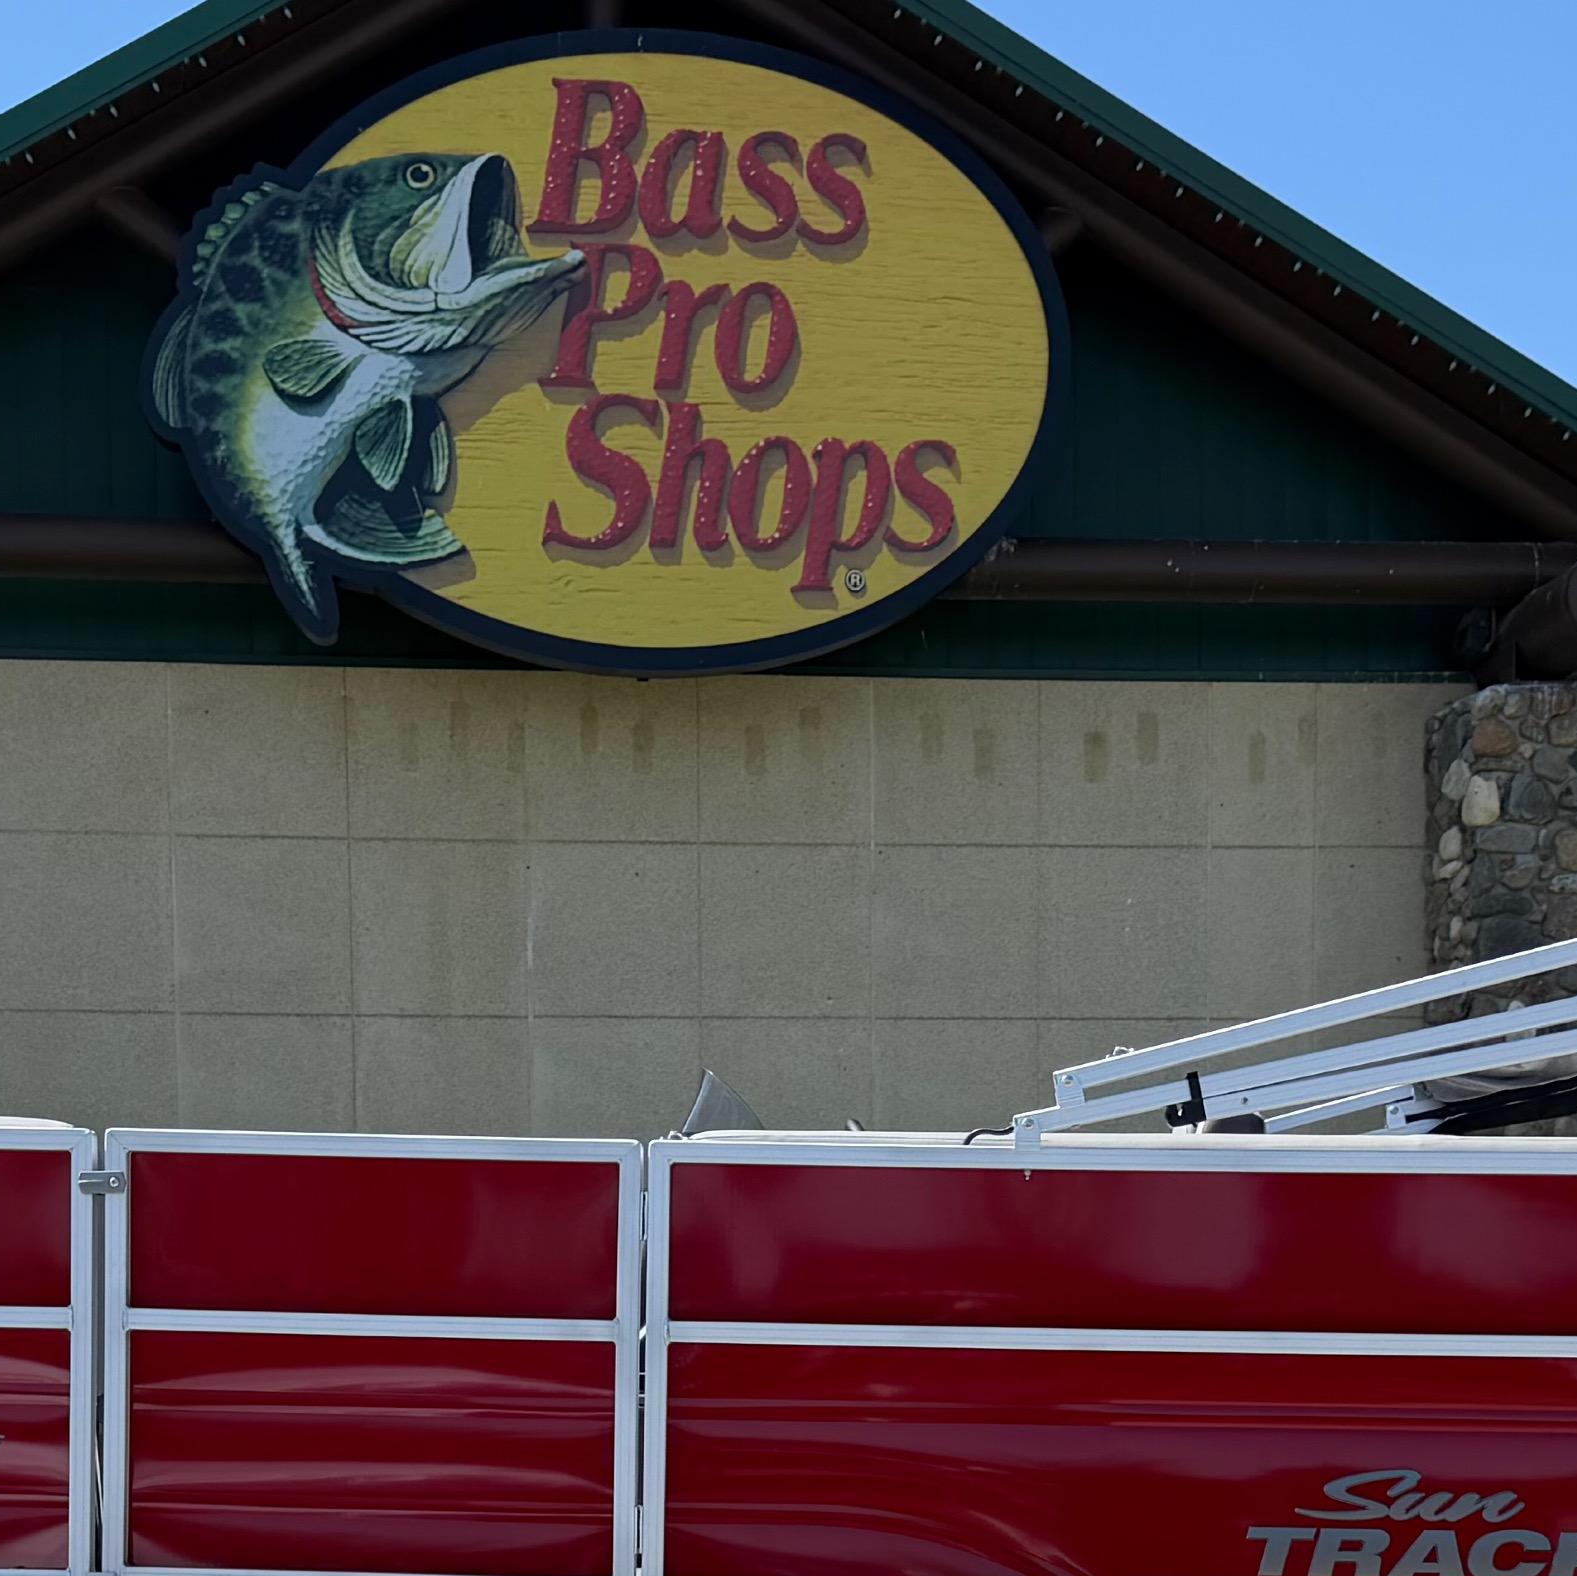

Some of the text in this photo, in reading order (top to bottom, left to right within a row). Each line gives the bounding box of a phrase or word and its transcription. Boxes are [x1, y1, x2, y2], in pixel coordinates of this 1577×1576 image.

[526, 77, 867, 245] Bass
[537, 240, 799, 393] Pro
[542, 393, 957, 592] Shops
[1294, 1468, 1525, 1524] Sun
